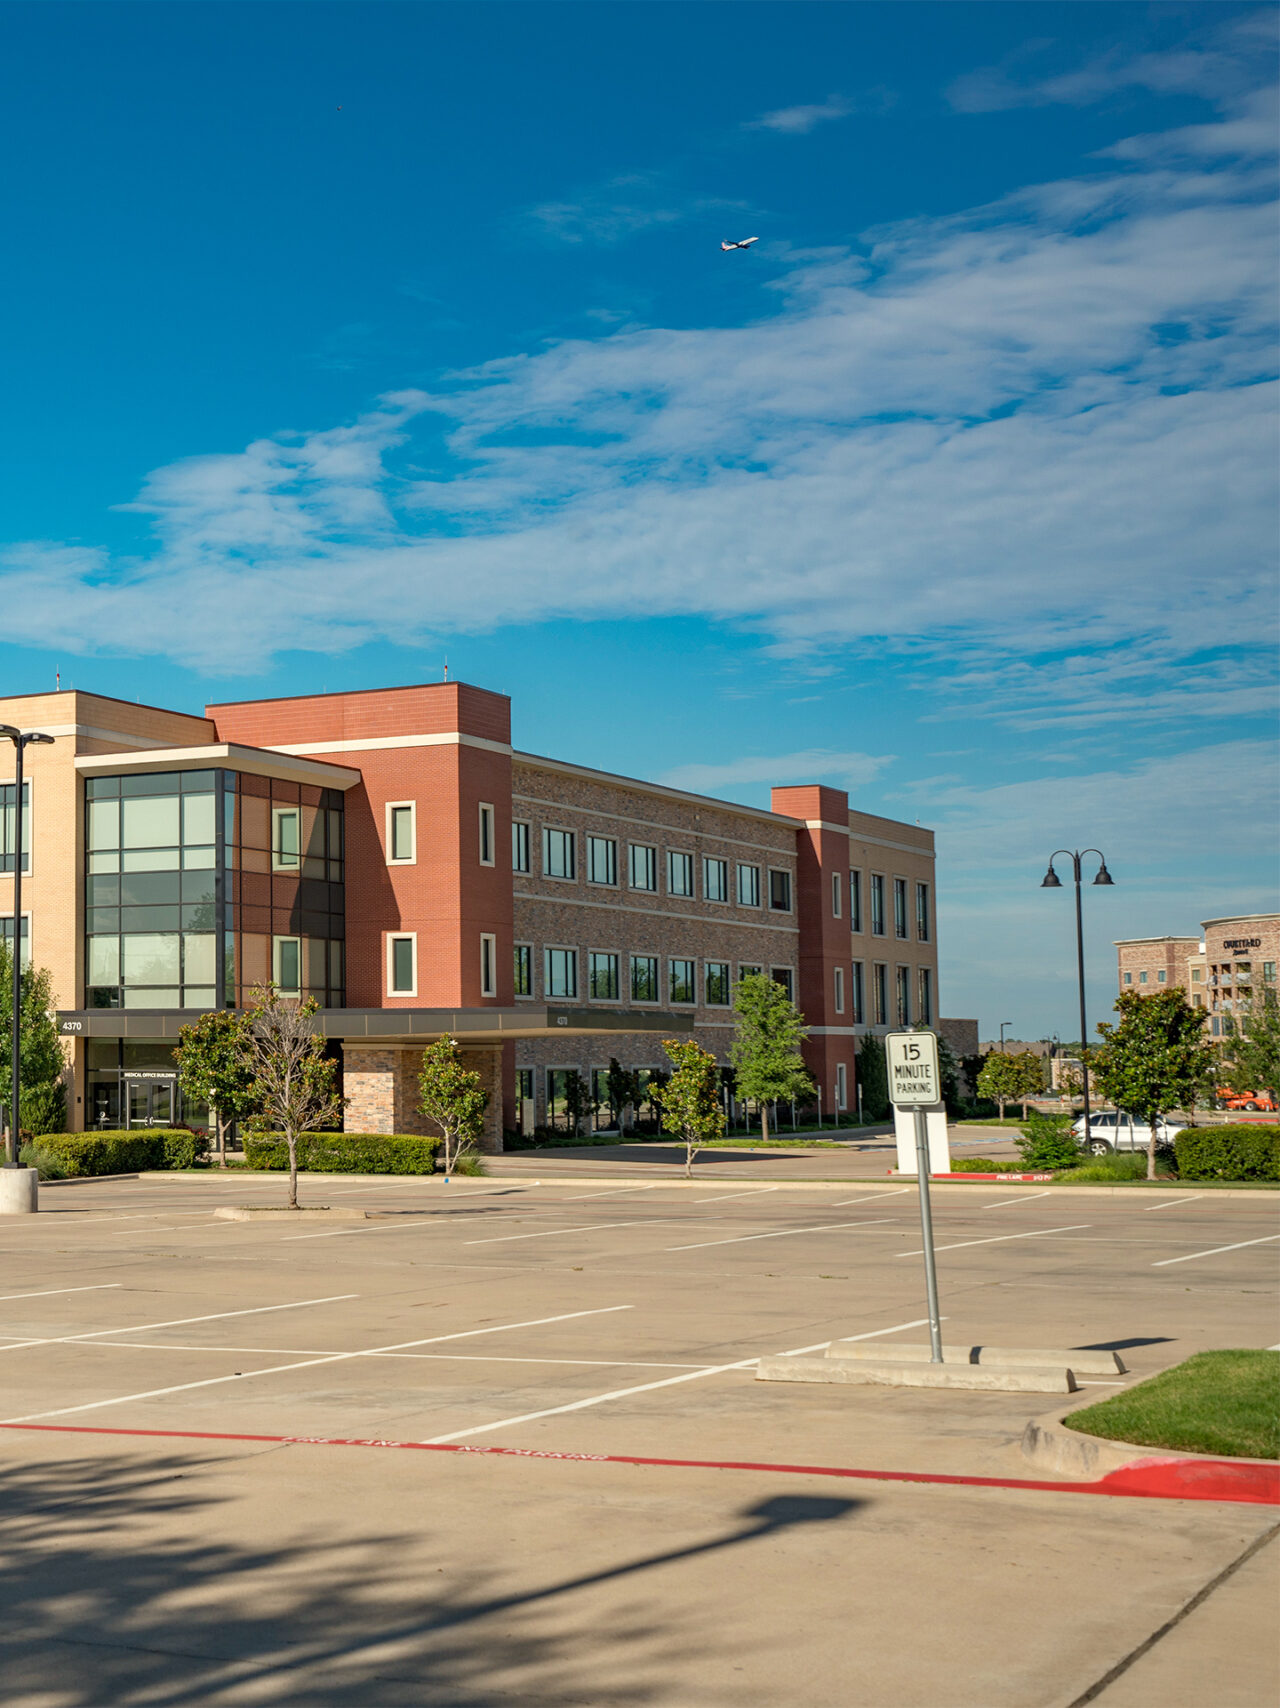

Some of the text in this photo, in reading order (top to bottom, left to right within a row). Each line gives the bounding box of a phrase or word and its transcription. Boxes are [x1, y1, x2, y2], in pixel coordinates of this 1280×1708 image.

[62, 1021, 82, 1030] 4370
[902, 1043, 920, 1061] 15
[894, 1064, 931, 1079] MINUTE
[896, 1082, 932, 1094] PARKING
